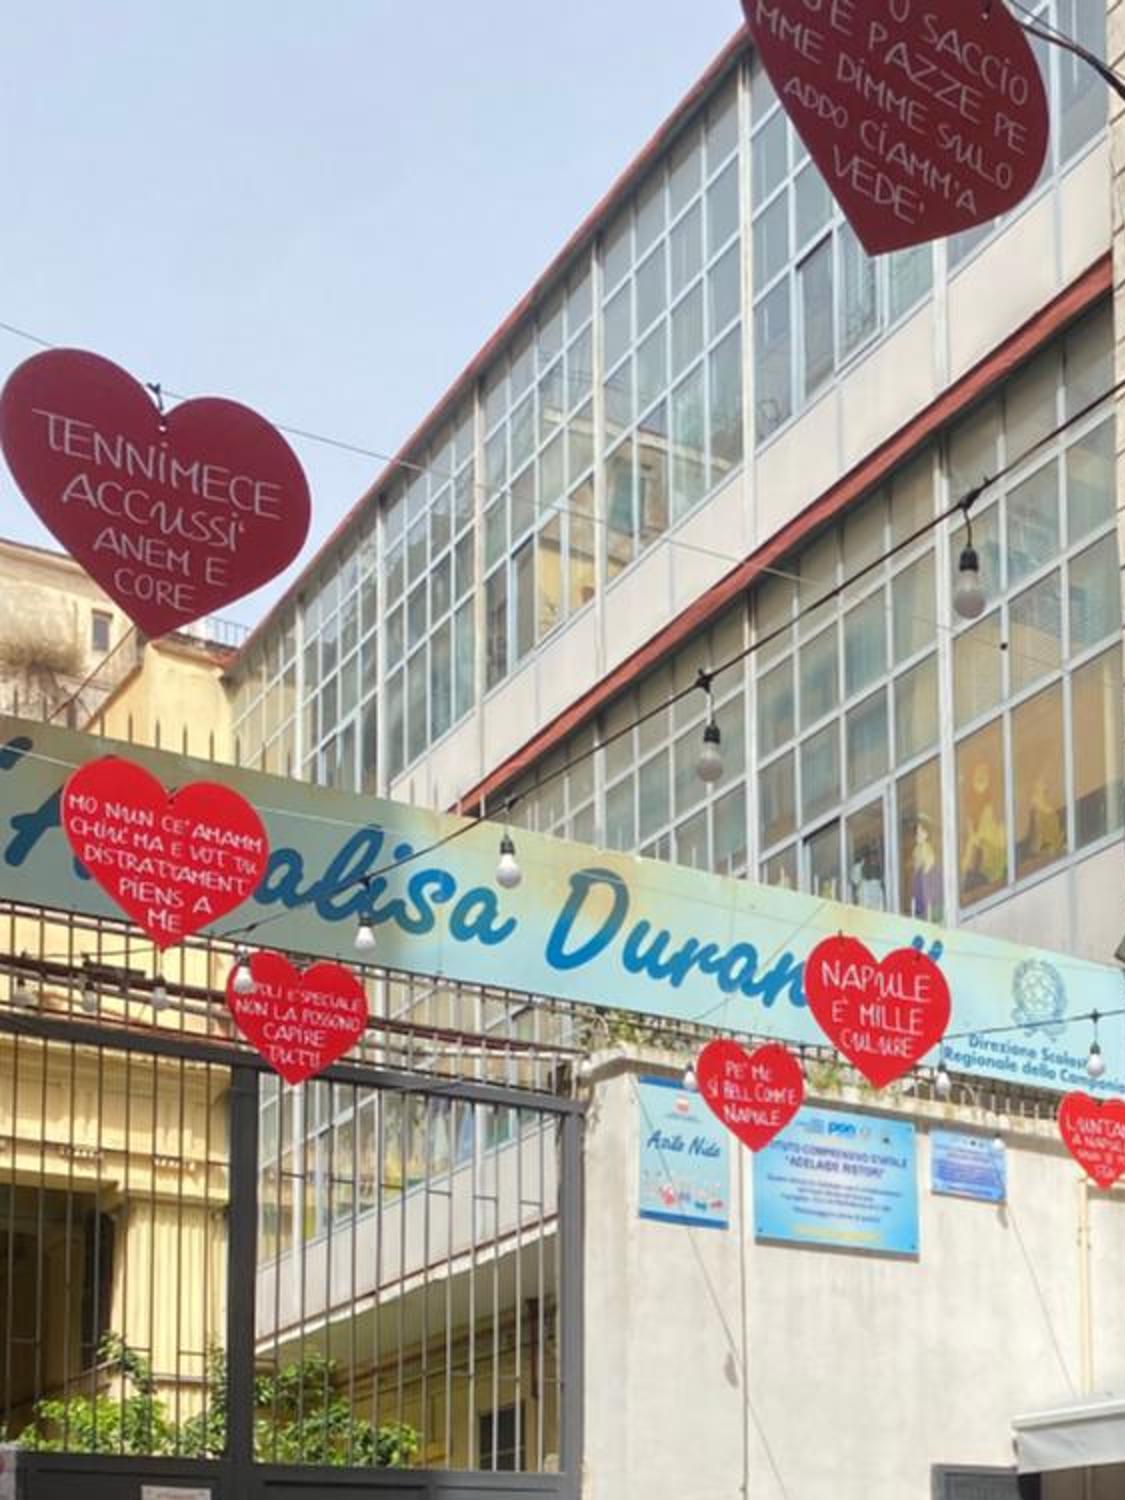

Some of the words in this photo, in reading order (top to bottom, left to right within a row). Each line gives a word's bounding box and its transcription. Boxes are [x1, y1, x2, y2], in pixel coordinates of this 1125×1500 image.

[869, 20, 982, 124] PAZZE
[922, 13, 1028, 105] SACCIO
[783, 76, 849, 129] ADDO
[836, 51, 928, 135] DIMME
[31, 406, 283, 521] TENNIMECE
[93, 527, 190, 576] ANEM
[205, 557, 228, 586] E
[115, 567, 195, 613] CORE
[105, 802, 154, 828] NUN
[84, 843, 251, 897] DISTRATTAMENT
[171, 842, 182, 857] E
[119, 876, 184, 909] PIENS
[192, 896, 212, 914] A
[147, 908, 181, 934] ME
[821, 958, 931, 1003] NAPULE
[273, 1003, 297, 1021] LA
[859, 997, 923, 1036] MILLE
[262, 1022, 328, 1048] CAPIRE
